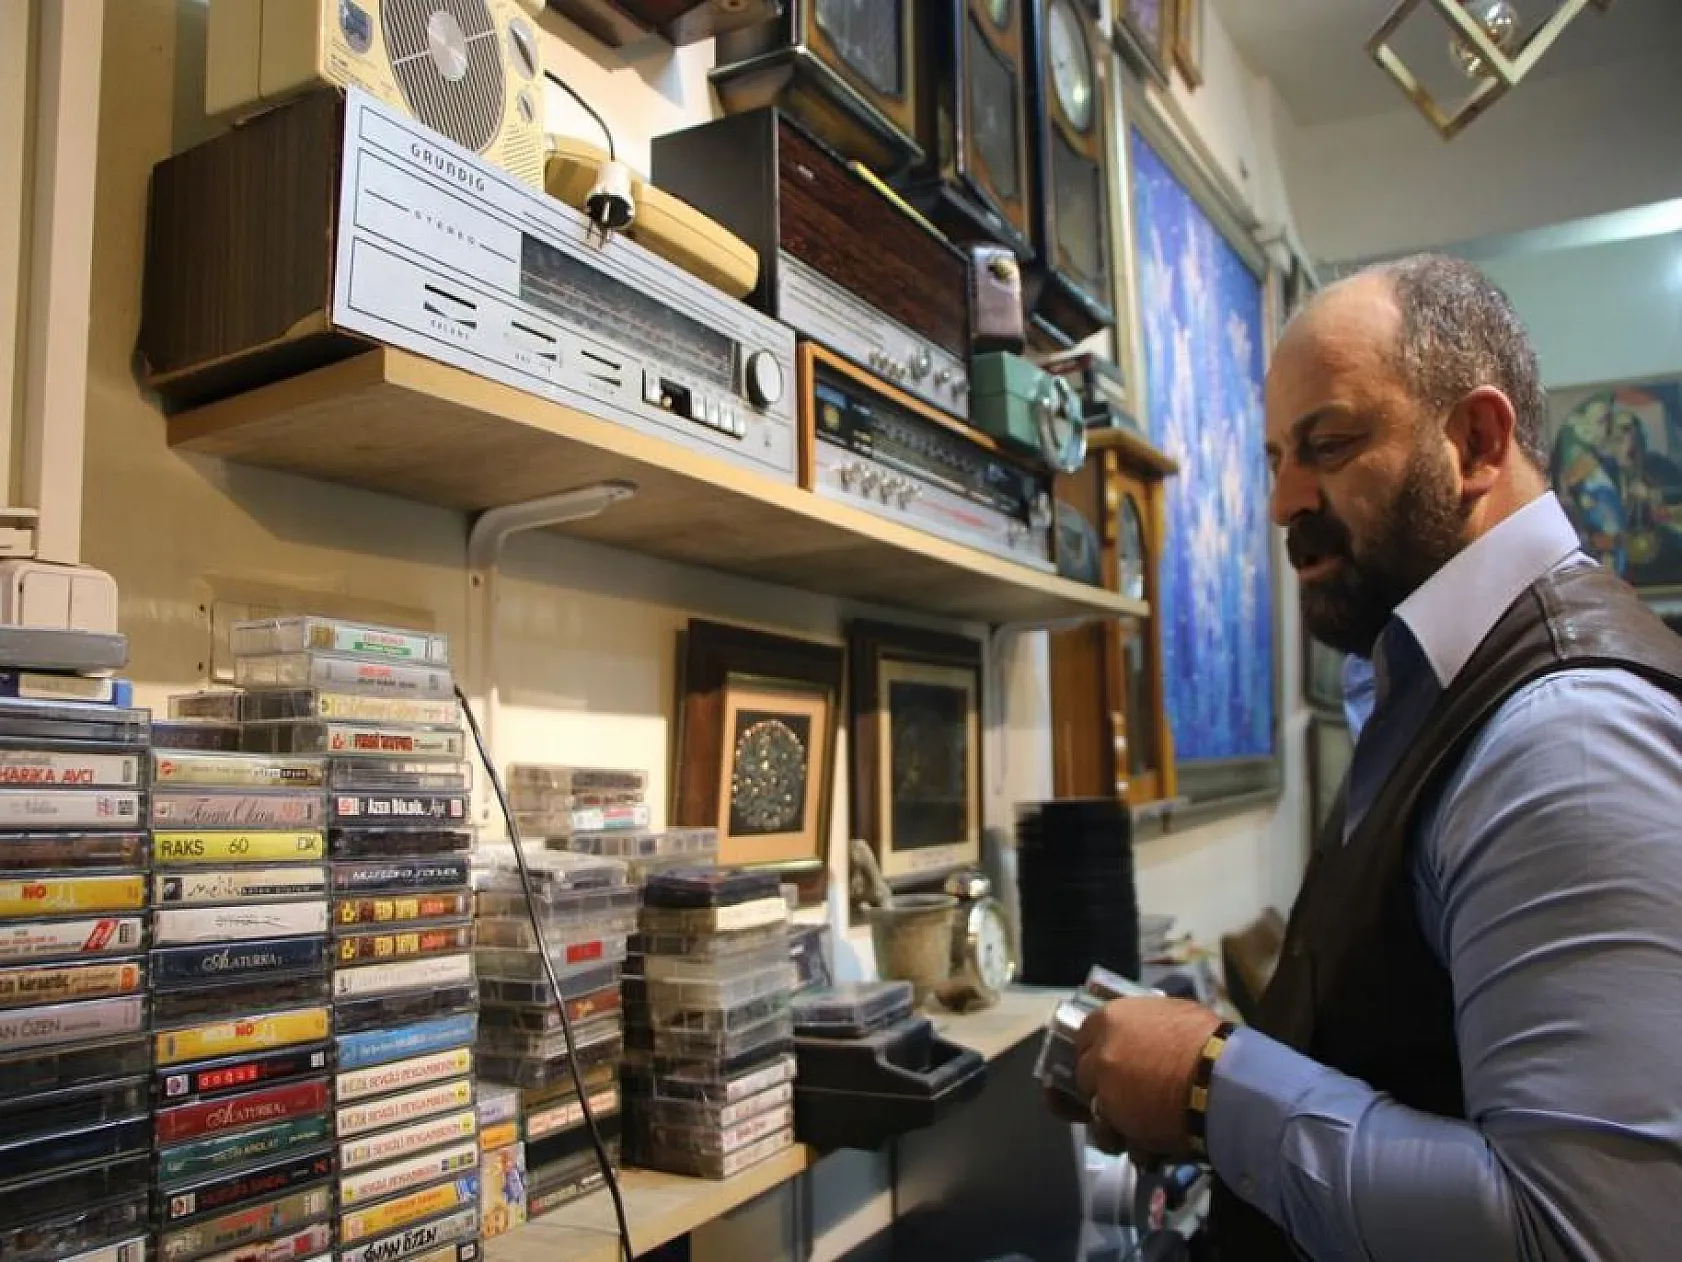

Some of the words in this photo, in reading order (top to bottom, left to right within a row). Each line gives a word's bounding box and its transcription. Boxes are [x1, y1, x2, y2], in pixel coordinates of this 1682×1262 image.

[410, 142, 486, 192] GRUNDIG
[413, 208, 476, 246] STEREO
[160, 839, 205, 857] RAKS
[227, 836, 250, 855] 60
